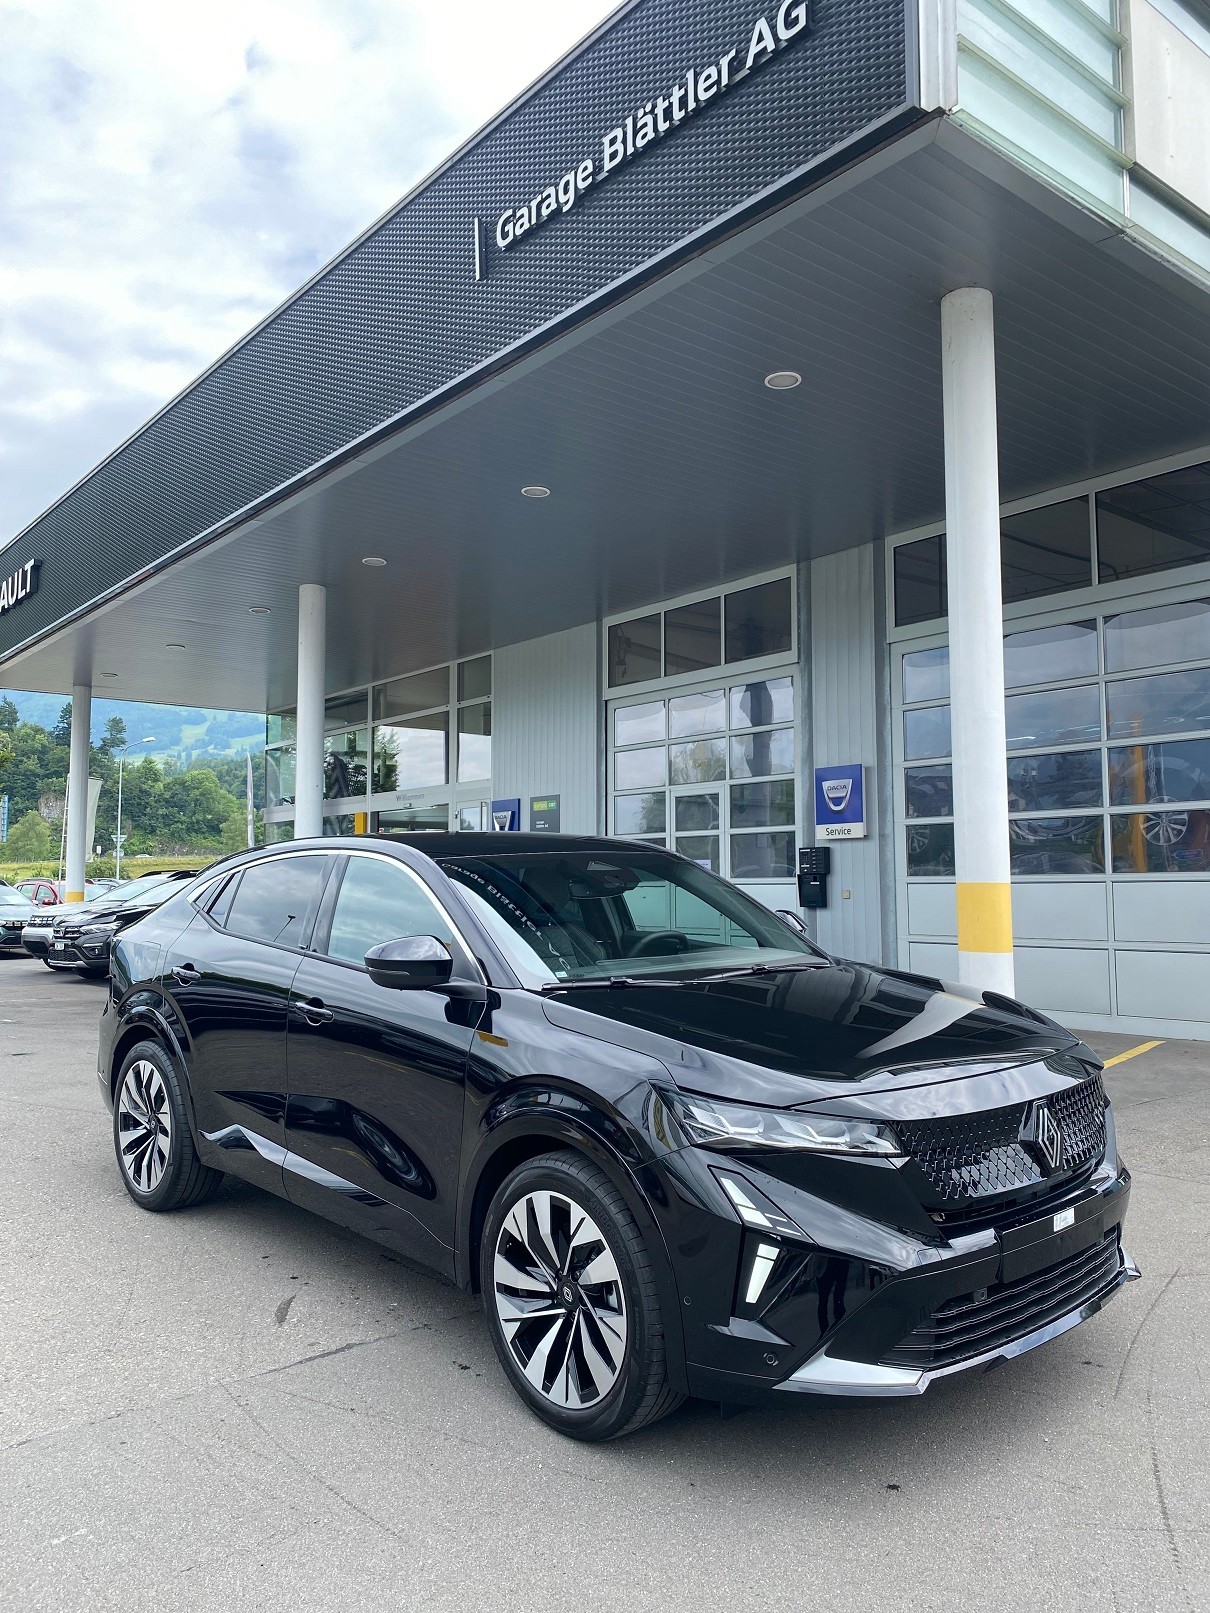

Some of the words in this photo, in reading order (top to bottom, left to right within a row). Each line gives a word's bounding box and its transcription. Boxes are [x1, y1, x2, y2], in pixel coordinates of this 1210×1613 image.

[496, 158, 593, 249] Garage
[602, 48, 736, 174] Blättler
[745, 0, 807, 69] AG
[0, 558, 35, 613] AULT
[825, 827, 852, 836] Service
